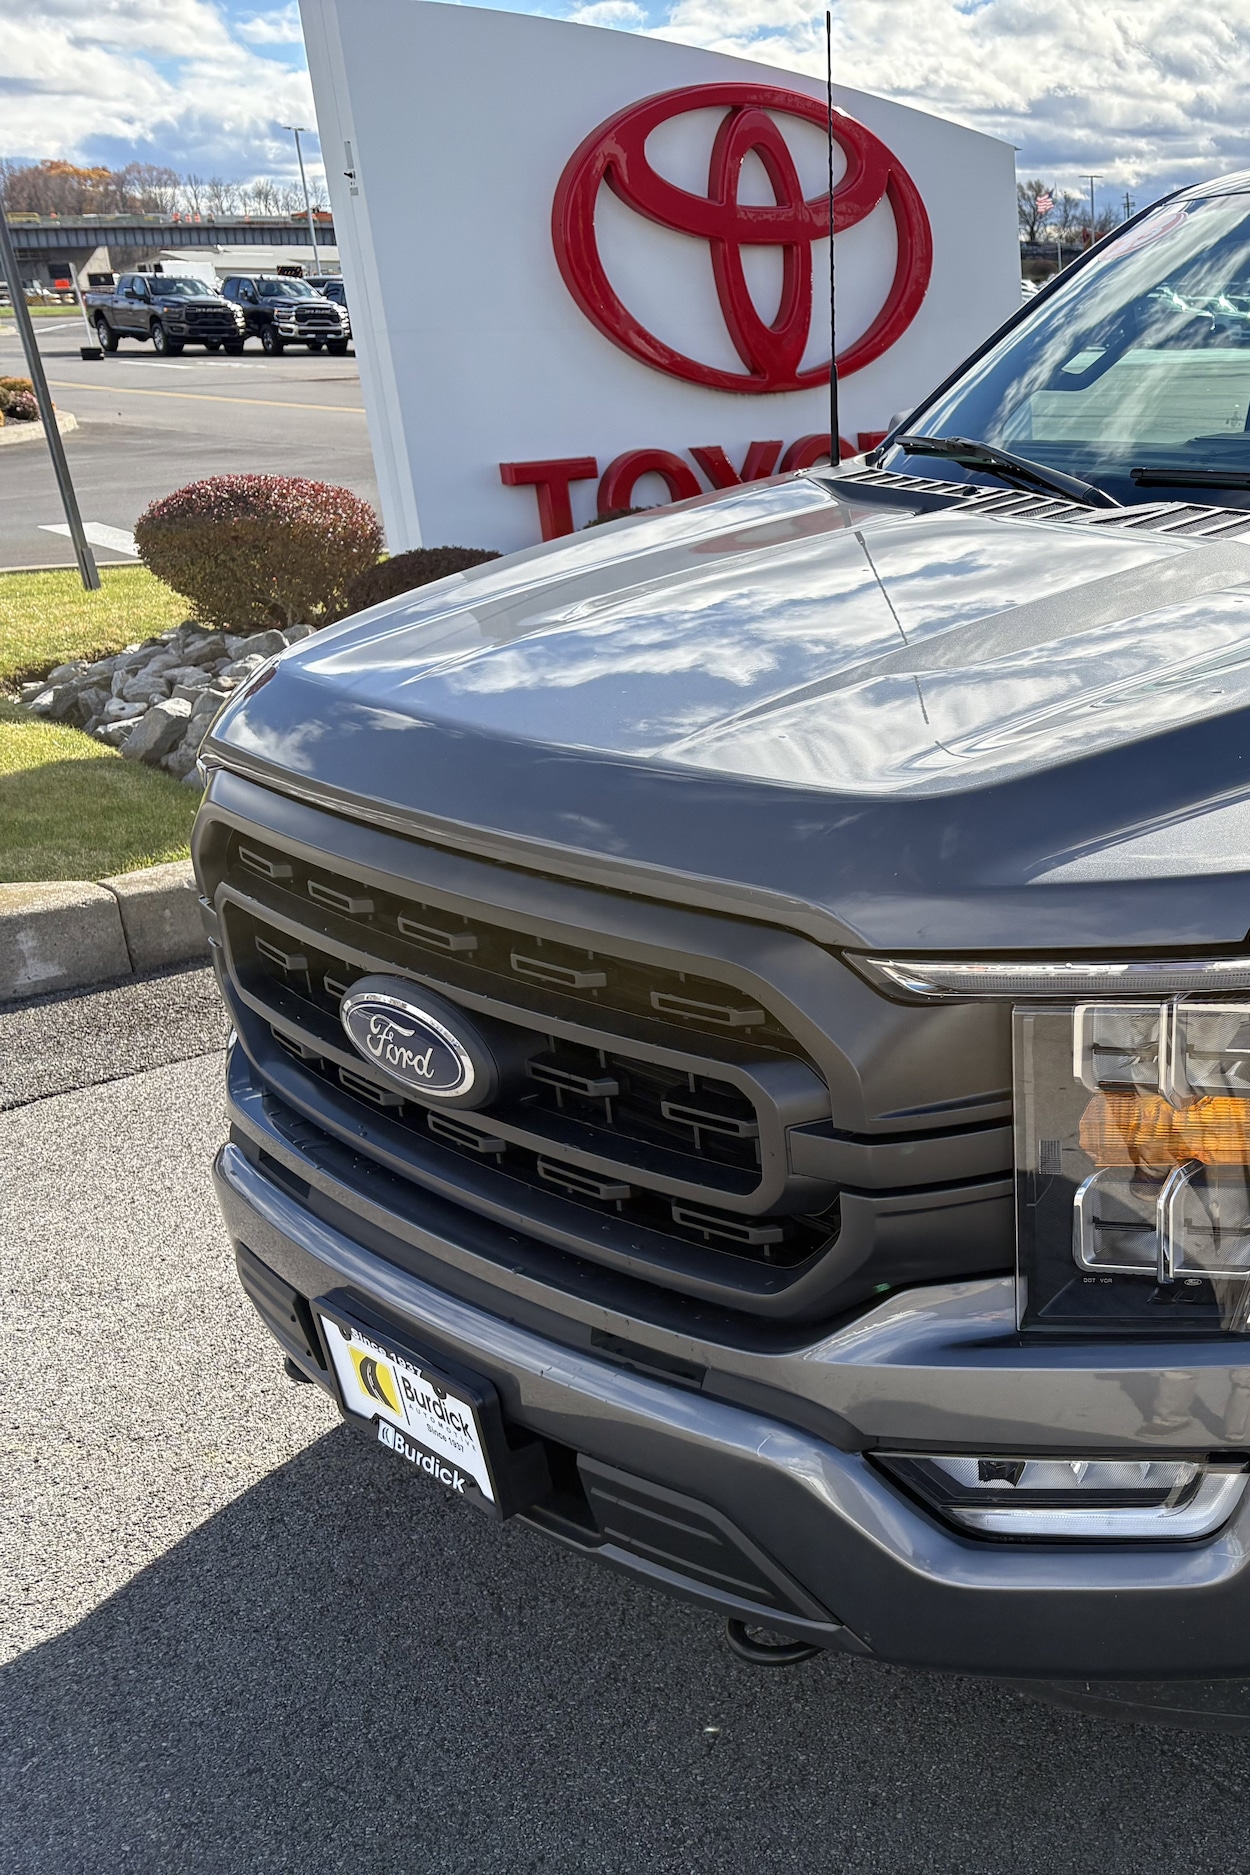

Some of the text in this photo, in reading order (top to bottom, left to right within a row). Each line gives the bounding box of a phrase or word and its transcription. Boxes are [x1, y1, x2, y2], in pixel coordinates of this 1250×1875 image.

[366, 1013, 435, 1079] Ford
[351, 1327, 422, 1377] Since 1937
[401, 1375, 474, 1442] Burdick
[409, 1403, 477, 1452] AUTOMOTIVE
[426, 1423, 447, 1442] Since
[394, 1432, 466, 1494] Burdick
